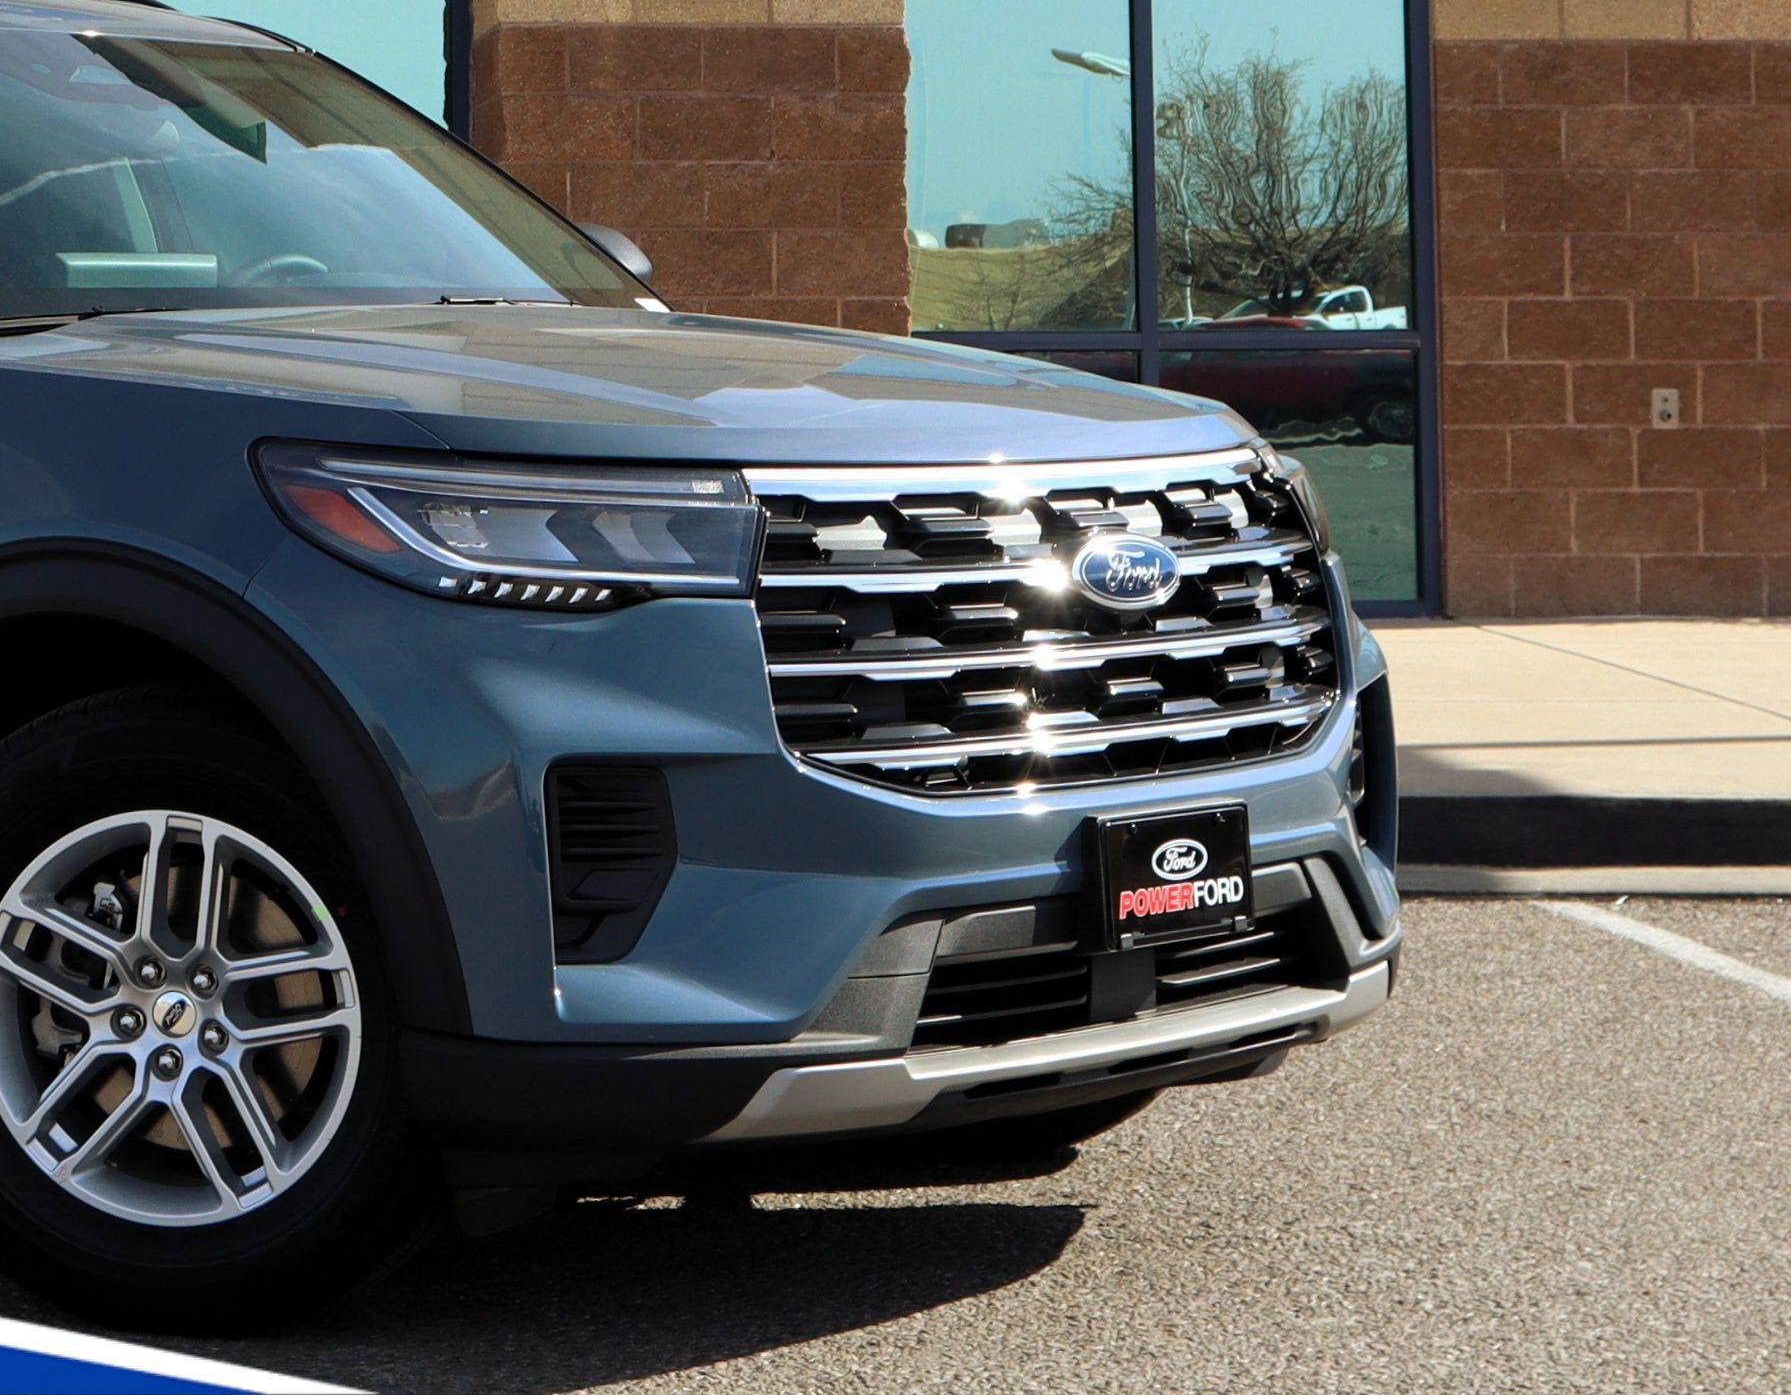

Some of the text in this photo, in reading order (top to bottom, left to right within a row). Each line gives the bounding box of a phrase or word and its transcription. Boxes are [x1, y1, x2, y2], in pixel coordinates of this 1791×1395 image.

[1105, 550, 1163, 592] Ford
[1162, 846, 1197, 872] Ford
[1119, 875, 1244, 920] POWERFORD
